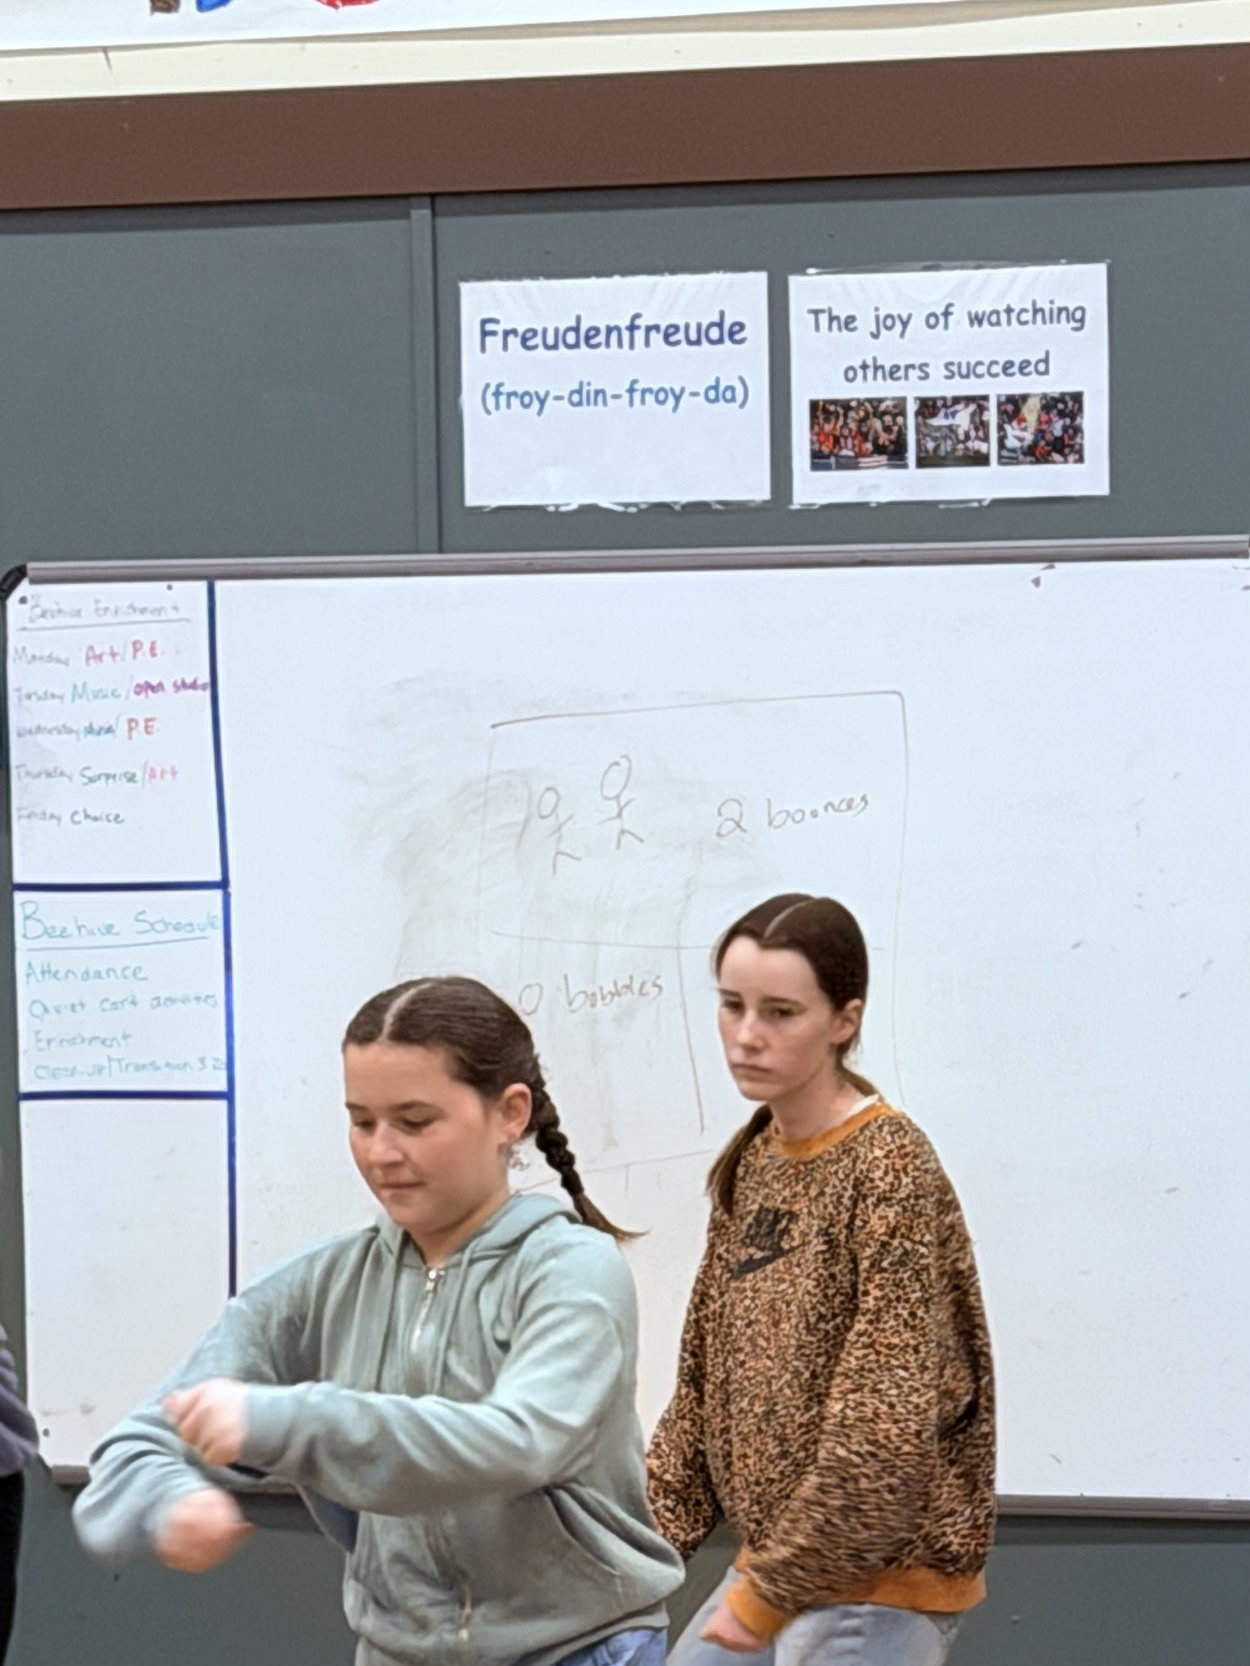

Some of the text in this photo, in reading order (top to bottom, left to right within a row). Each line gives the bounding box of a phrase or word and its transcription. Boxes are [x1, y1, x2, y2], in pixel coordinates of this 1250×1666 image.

[479, 310, 747, 353] Freudenfreude
[808, 299, 1087, 339] The joy of watching
[843, 350, 1051, 384] others succeed
[481, 375, 750, 416] (froy-din-froy-da)
[716, 793, 869, 837] 2 bounces
[20, 900, 120, 940] Beehive
[25, 960, 149, 984] Attendance
